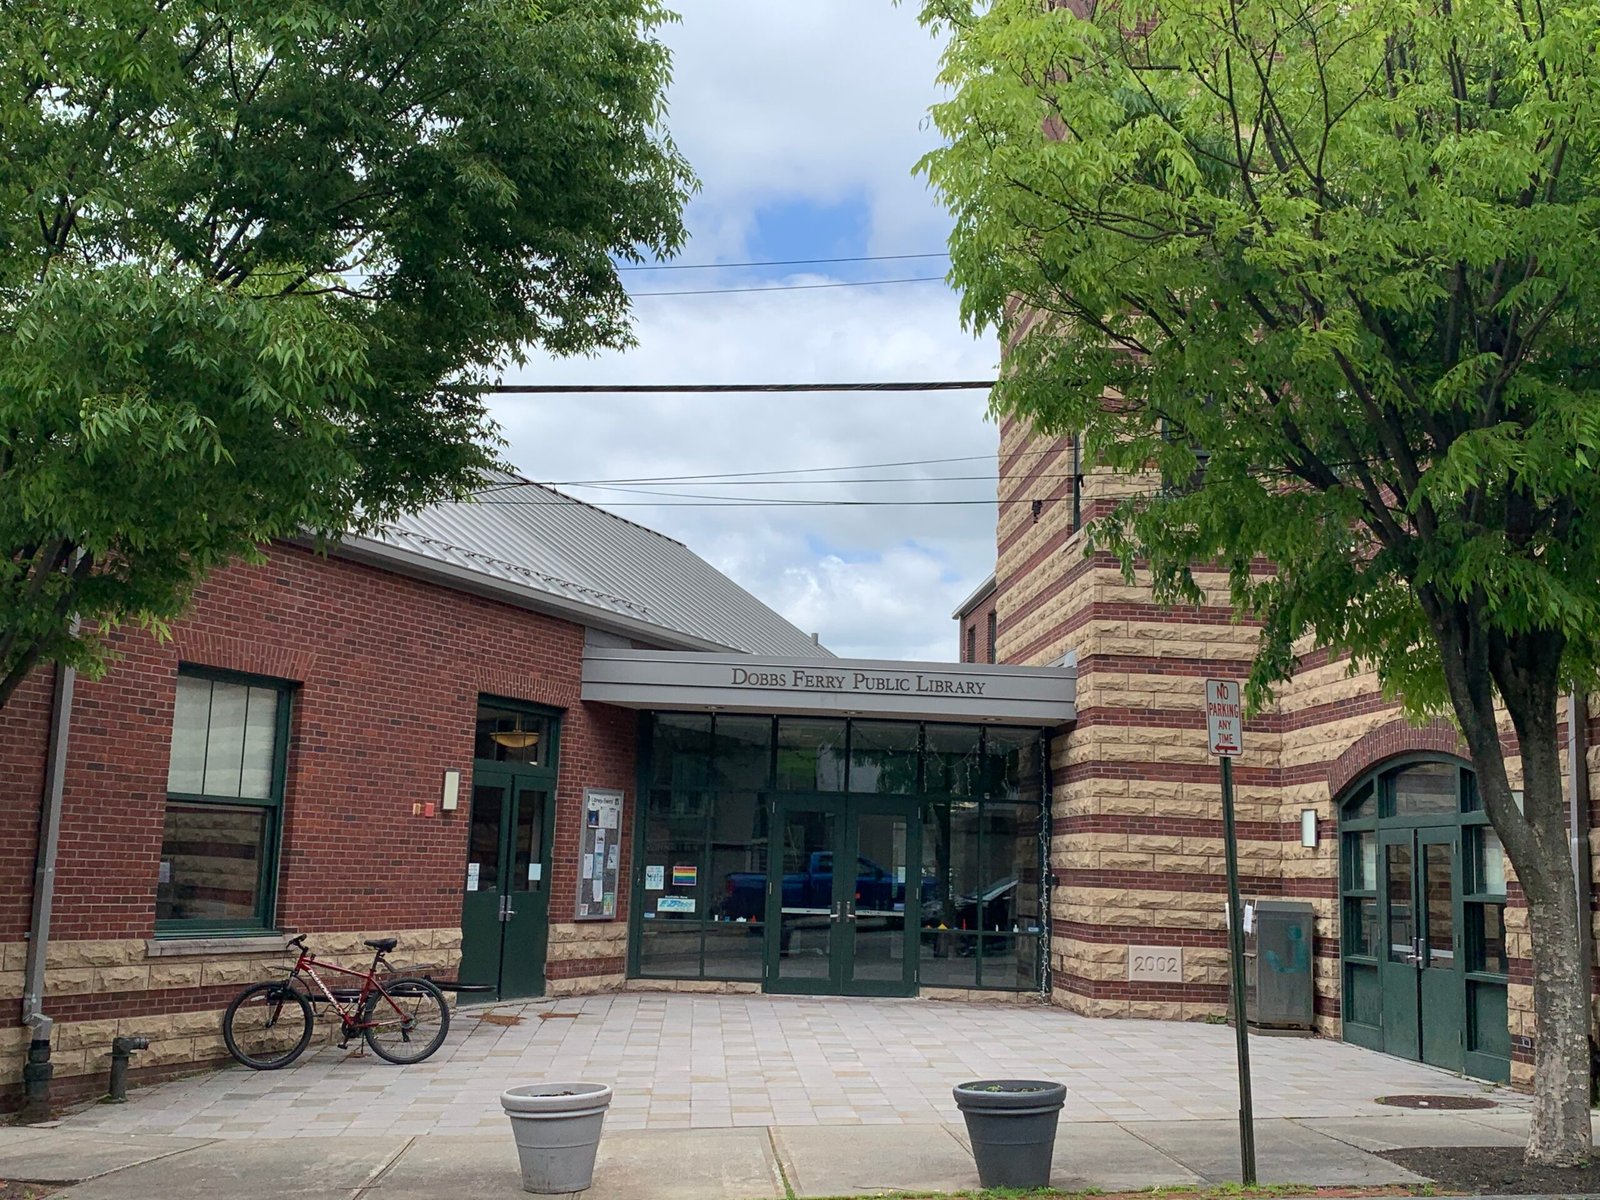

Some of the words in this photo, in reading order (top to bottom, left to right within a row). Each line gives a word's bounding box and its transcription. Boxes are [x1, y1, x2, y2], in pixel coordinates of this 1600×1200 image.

[731, 668, 786, 686] DOBBS
[792, 670, 846, 689] FERRY
[853, 673, 909, 692] PUBLIC
[916, 675, 986, 695] LIBRARY
[1216, 685, 1229, 700] NO
[1209, 703, 1238, 718] PARKING
[1218, 720, 1231, 730] ANY
[1218, 733, 1233, 744] TIME
[1134, 956, 1177, 972] 2002
